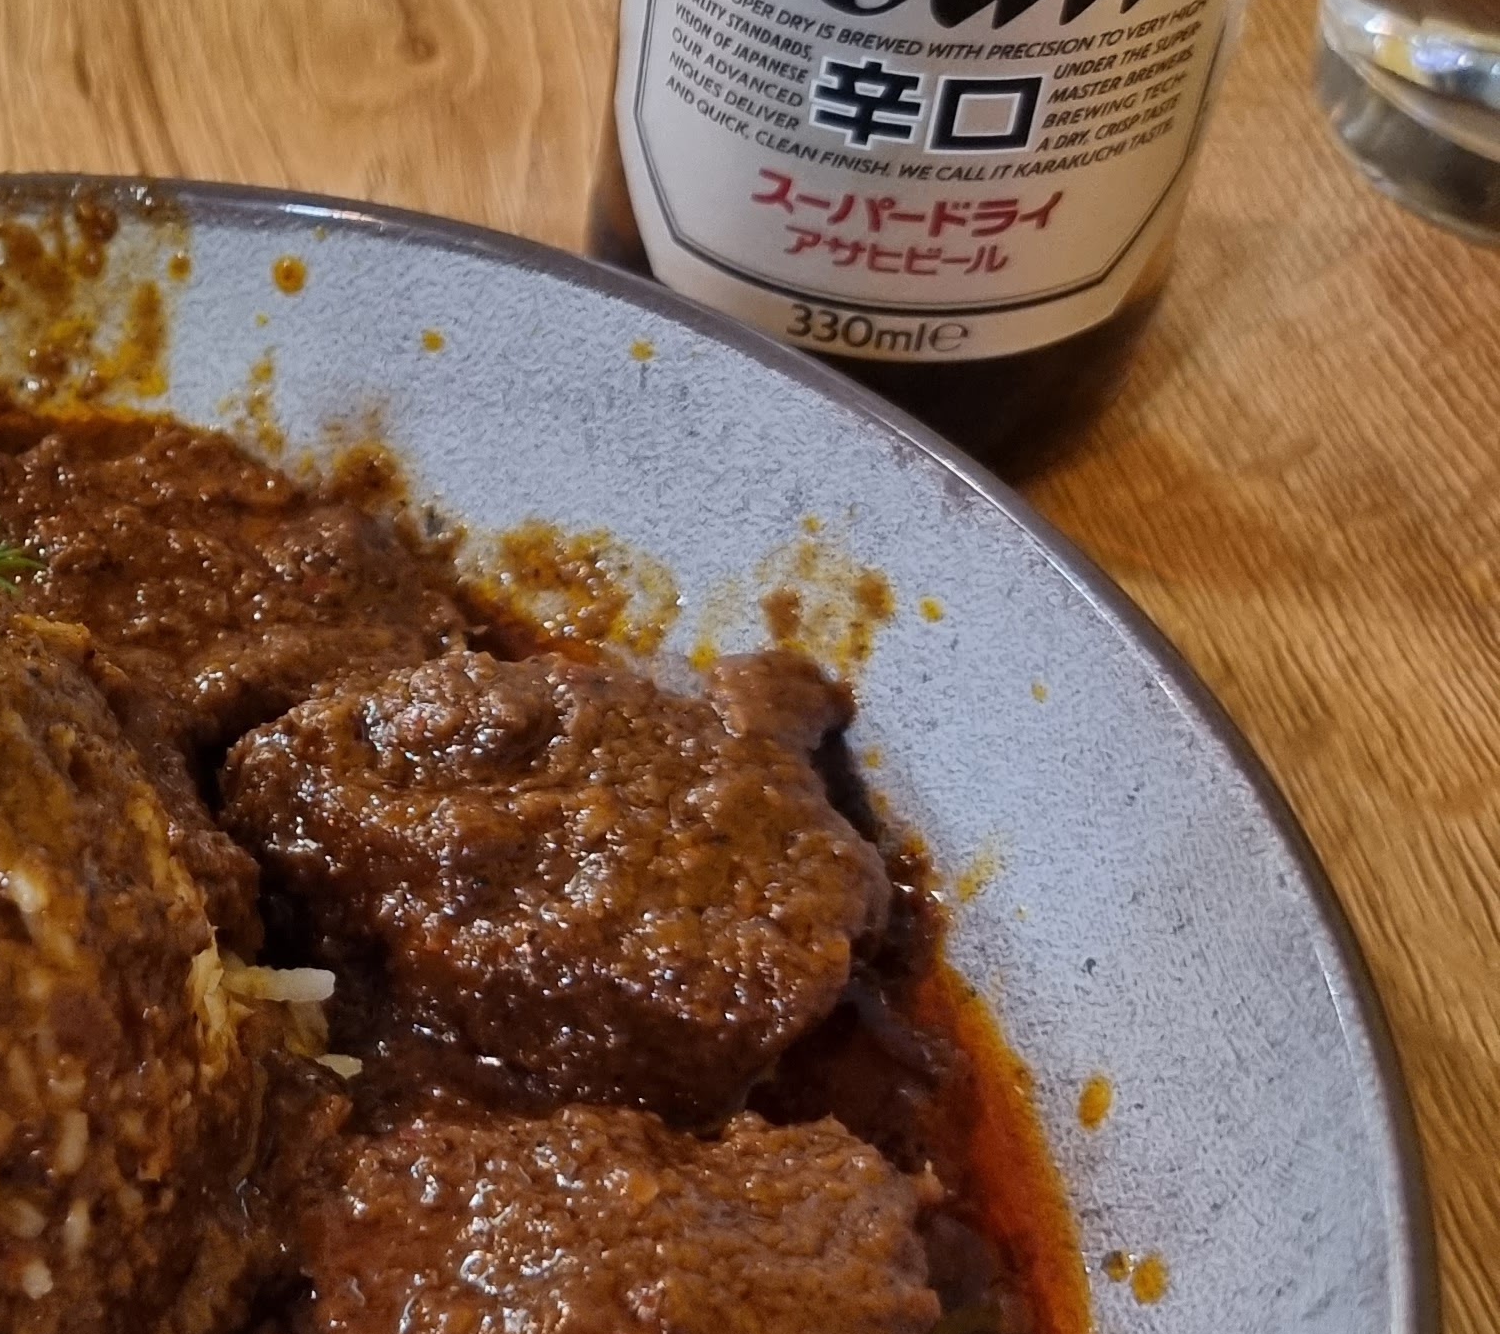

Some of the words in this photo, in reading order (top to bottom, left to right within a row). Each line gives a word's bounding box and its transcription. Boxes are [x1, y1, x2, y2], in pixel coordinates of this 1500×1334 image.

[671, 26, 702, 58] OUR
[703, 53, 804, 108] ADVANCED
[1041, 93, 1139, 129] BREWING
[675, 2, 713, 40] VISION
[713, 31, 733, 51] OF
[731, 43, 809, 85] JAPANESE
[1047, 75, 1122, 105] MASTER
[726, 13, 813, 62] STANDARDS,
[1053, 50, 1117, 80] UNDER
[1118, 42, 1153, 66] THE
[775, 10, 816, 34] DRY
[816, 22, 836, 40] IS
[837, 29, 923, 56] BREWED
[927, 42, 983, 60] WITH
[985, 35, 1096, 60] PRECISION
[1097, 28, 1125, 49] TO
[1125, 17, 1167, 41] VERY
[665, 75, 695, 105] AND
[755, 130, 819, 163] CLEAN
[818, 150, 891, 177] FINISH.
[897, 163, 931, 181] WE
[934, 164, 984, 182] CALL
[988, 163, 1014, 181] IT
[1012, 140, 1127, 179] KARAKUCHI
[669, 51, 723, 98] NIQUES
[723, 89, 800, 131] DELIVER
[1035, 136, 1050, 153] A
[1094, 112, 1141, 141] CRISP
[1140, 91, 1182, 123] TASTE
[811, 56, 1046, 153] 辛口
[751, 167, 1065, 238] スーパードライ
[783, 224, 1010, 276] アサヒビール
